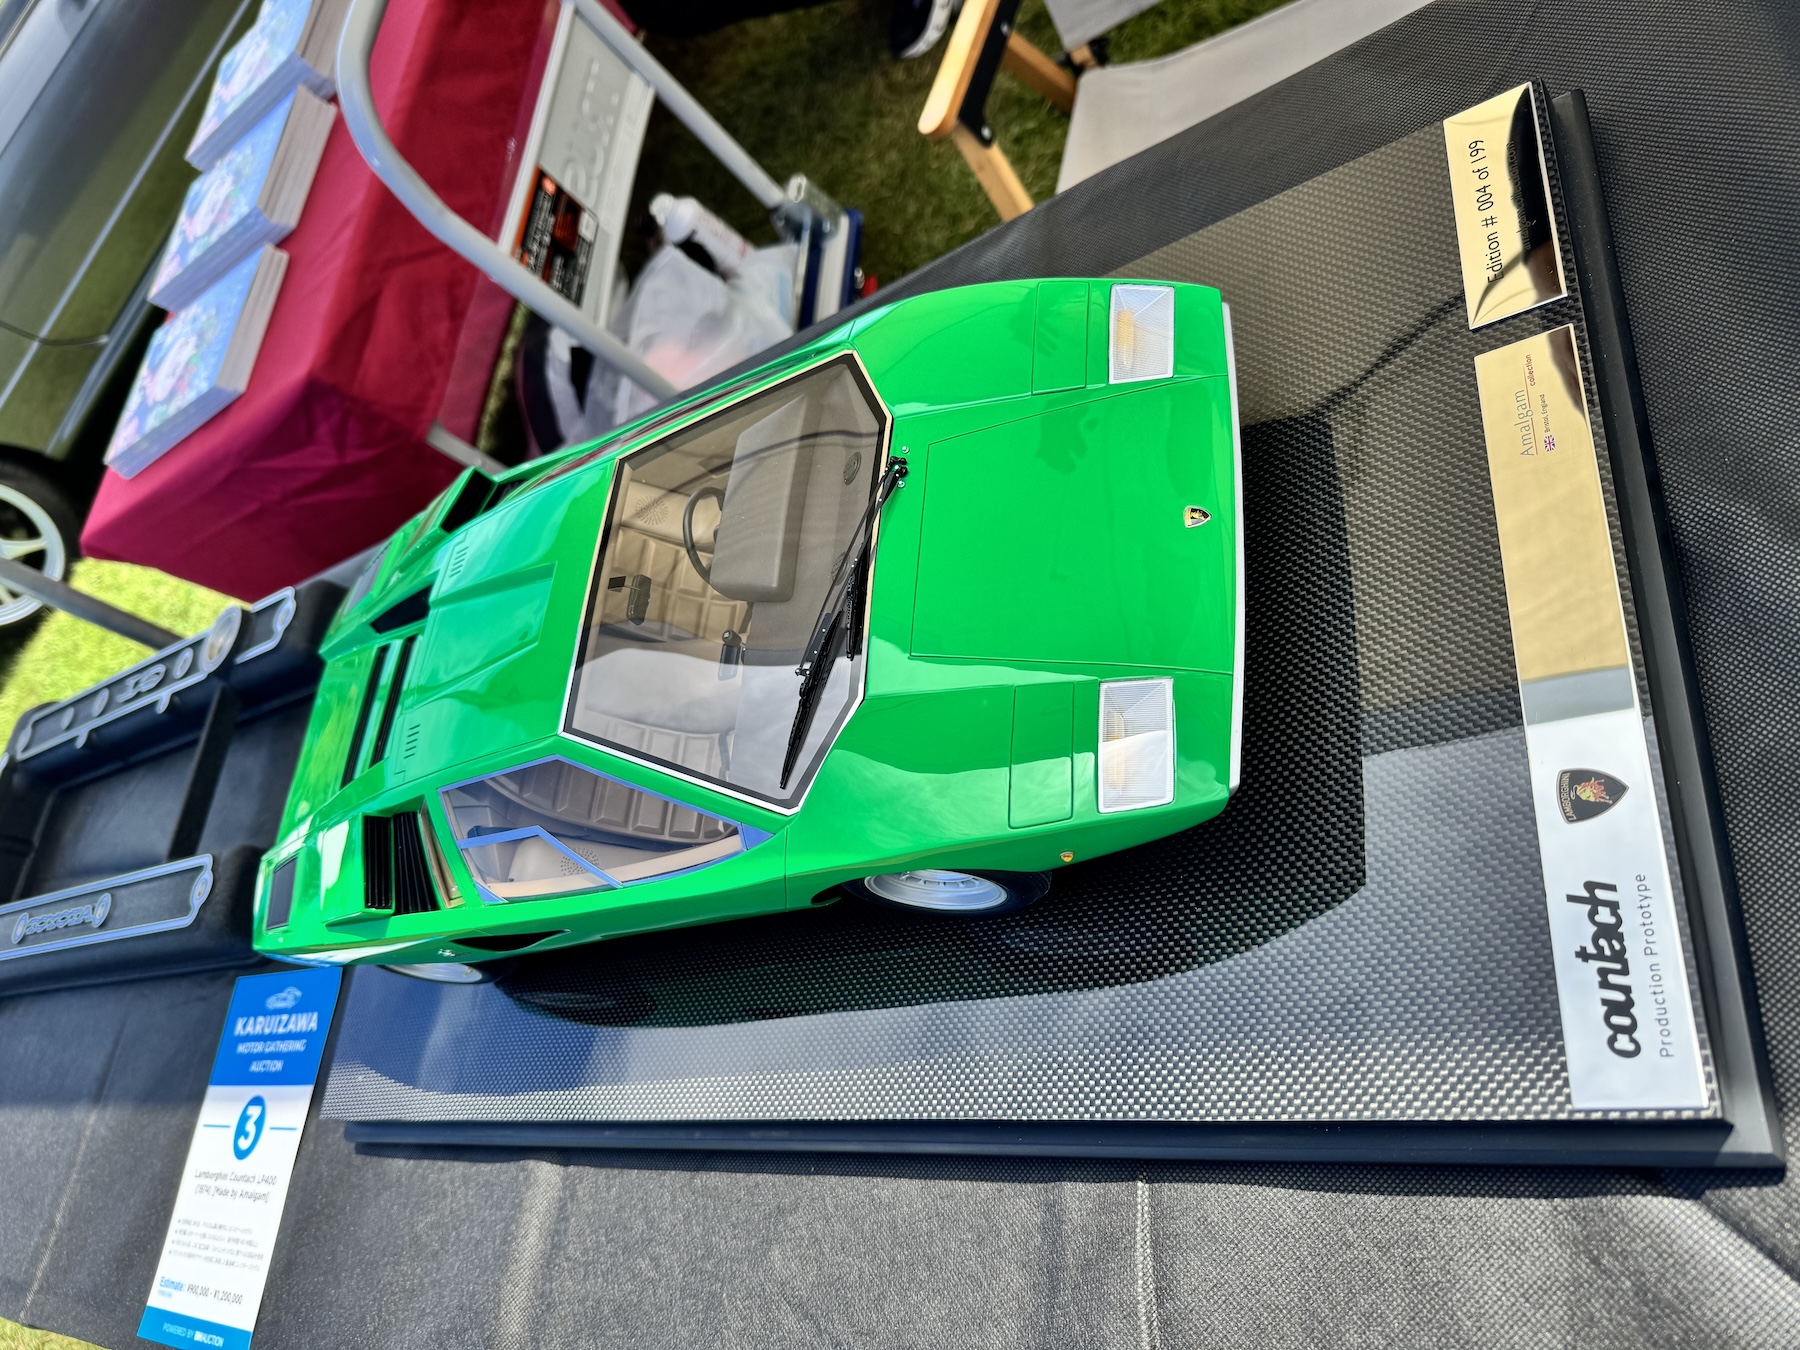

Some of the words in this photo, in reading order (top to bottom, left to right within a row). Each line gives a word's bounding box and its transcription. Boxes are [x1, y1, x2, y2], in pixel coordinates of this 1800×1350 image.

[1468, 139, 1487, 164] 199
[1472, 166, 1489, 180] of
[1475, 184, 1494, 212] 004
[1506, 140, 1532, 251] amalgamcollection.com
[1481, 215, 1498, 228] #
[1485, 231, 1505, 284] Edition
[1525, 353, 1536, 387] collection
[1539, 394, 1549, 414] England
[1514, 389, 1535, 456] Amalgam
[1542, 414, 1551, 433] Bristol,
[1560, 772, 1577, 821] LAMBORGHINI
[1635, 873, 1658, 957] Prototype
[1566, 880, 1642, 1059] countach
[234, 1011, 319, 1037] KARUIZAWA
[1649, 962, 1675, 1059] Production
[236, 1040, 264, 1055] MOTOR
[264, 1039, 308, 1054] GATHERING
[249, 1059, 285, 1073] AUCTION
[237, 1105, 263, 1151] 3
